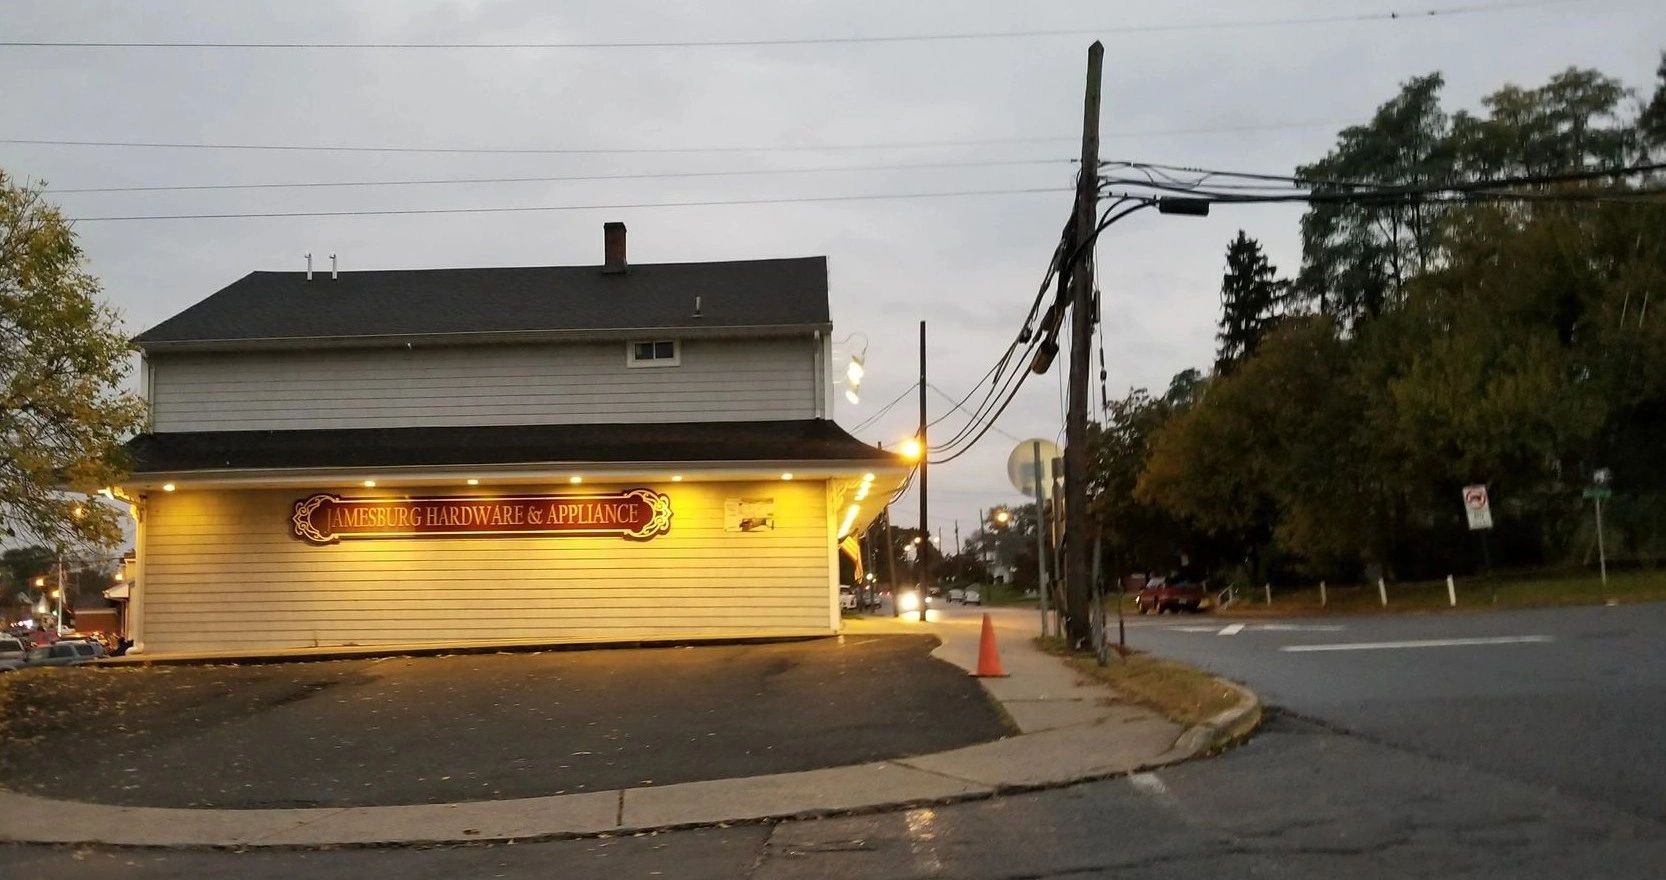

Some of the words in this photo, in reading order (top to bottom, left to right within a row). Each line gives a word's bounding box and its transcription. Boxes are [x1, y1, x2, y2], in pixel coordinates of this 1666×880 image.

[325, 506, 421, 533] JAMESBURG
[426, 505, 524, 527] HARDWARE
[527, 505, 543, 525] &
[546, 503, 638, 525] APPLIANCE
